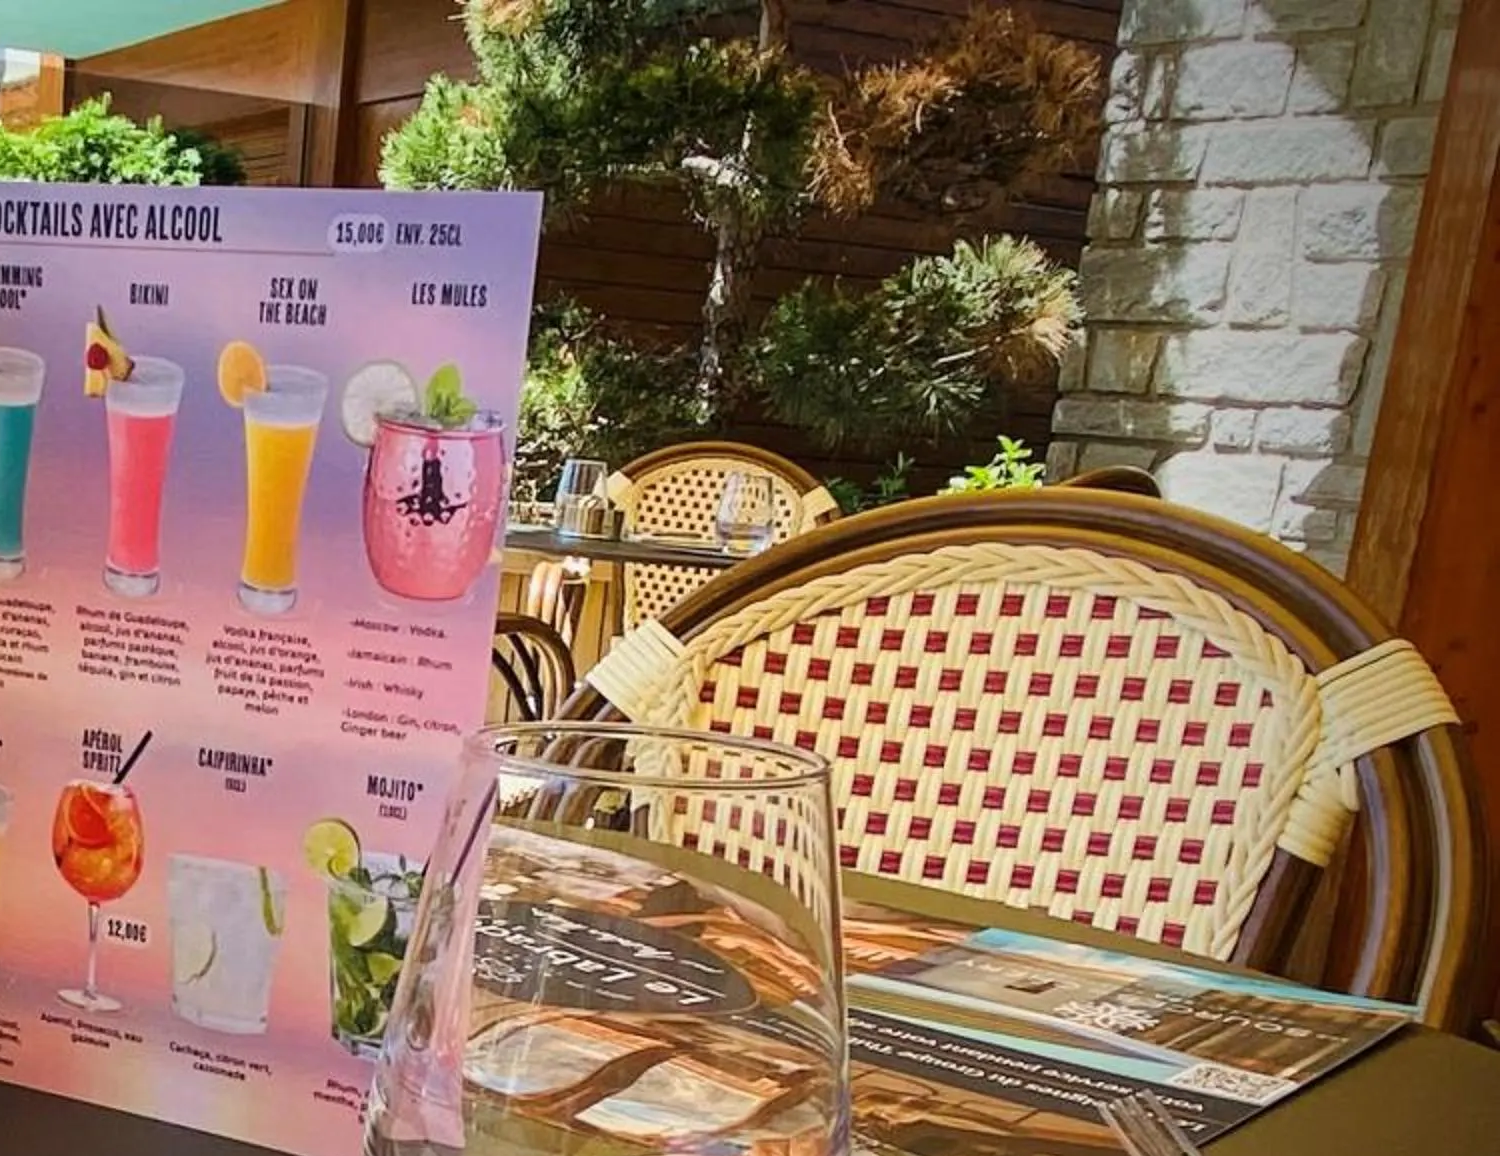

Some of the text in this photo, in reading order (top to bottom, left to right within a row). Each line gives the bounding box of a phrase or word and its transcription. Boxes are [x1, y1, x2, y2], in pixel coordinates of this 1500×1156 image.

[90, 203, 138, 239] AVEC
[144, 204, 223, 243] ALCOOL
[336, 221, 385, 247] 15,00€
[396, 223, 463, 247] ENV. 25CL
[129, 282, 169, 305] BIKINI
[270, 276, 318, 300] SEX ON
[411, 282, 488, 307] LES MULES
[259, 302, 327, 326] THE BEACH
[82, 728, 124, 754] APÉROL
[339, 720, 379, 740] Ginger
[82, 750, 123, 775] SPRITZ
[107, 918, 148, 943] 12,00€
